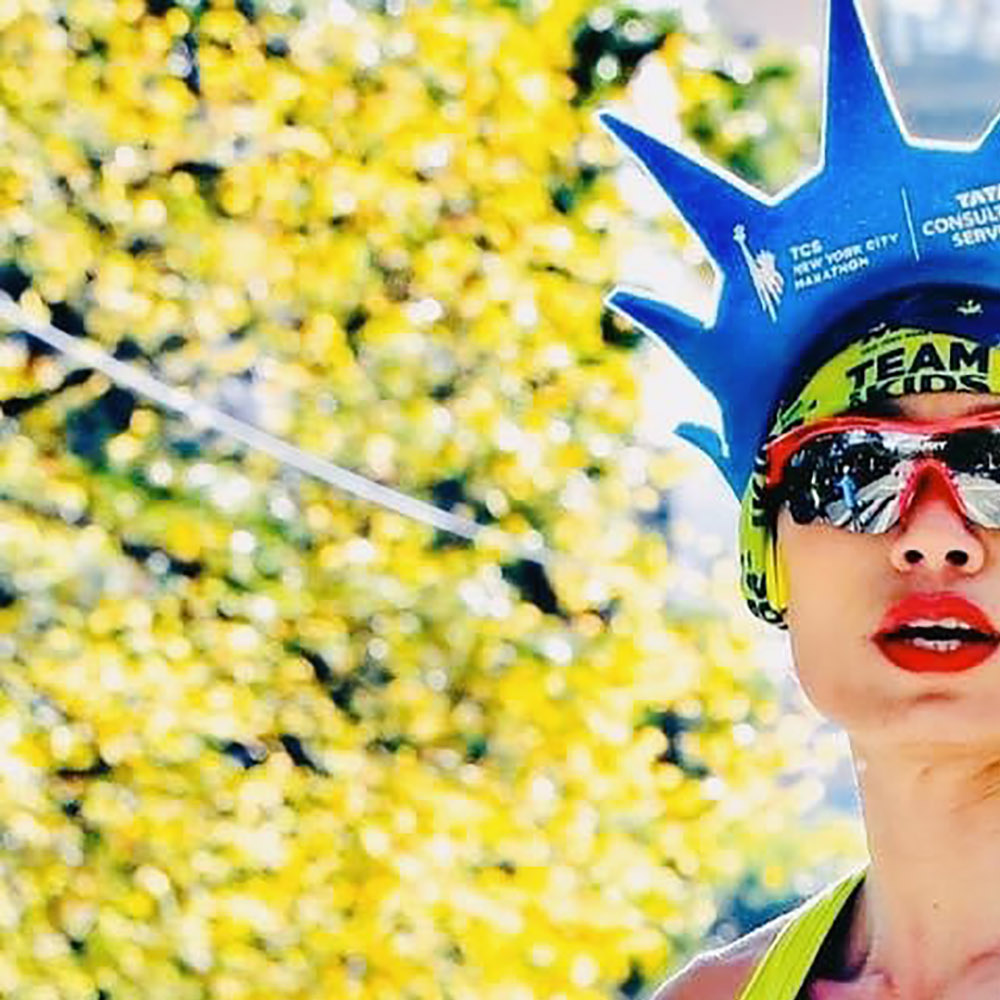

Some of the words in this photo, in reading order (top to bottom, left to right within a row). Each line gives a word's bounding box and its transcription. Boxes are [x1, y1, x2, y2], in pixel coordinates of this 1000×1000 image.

[789, 239, 822, 260] TCS
[865, 233, 899, 251] CITY
[846, 342, 990, 389] TEAM
